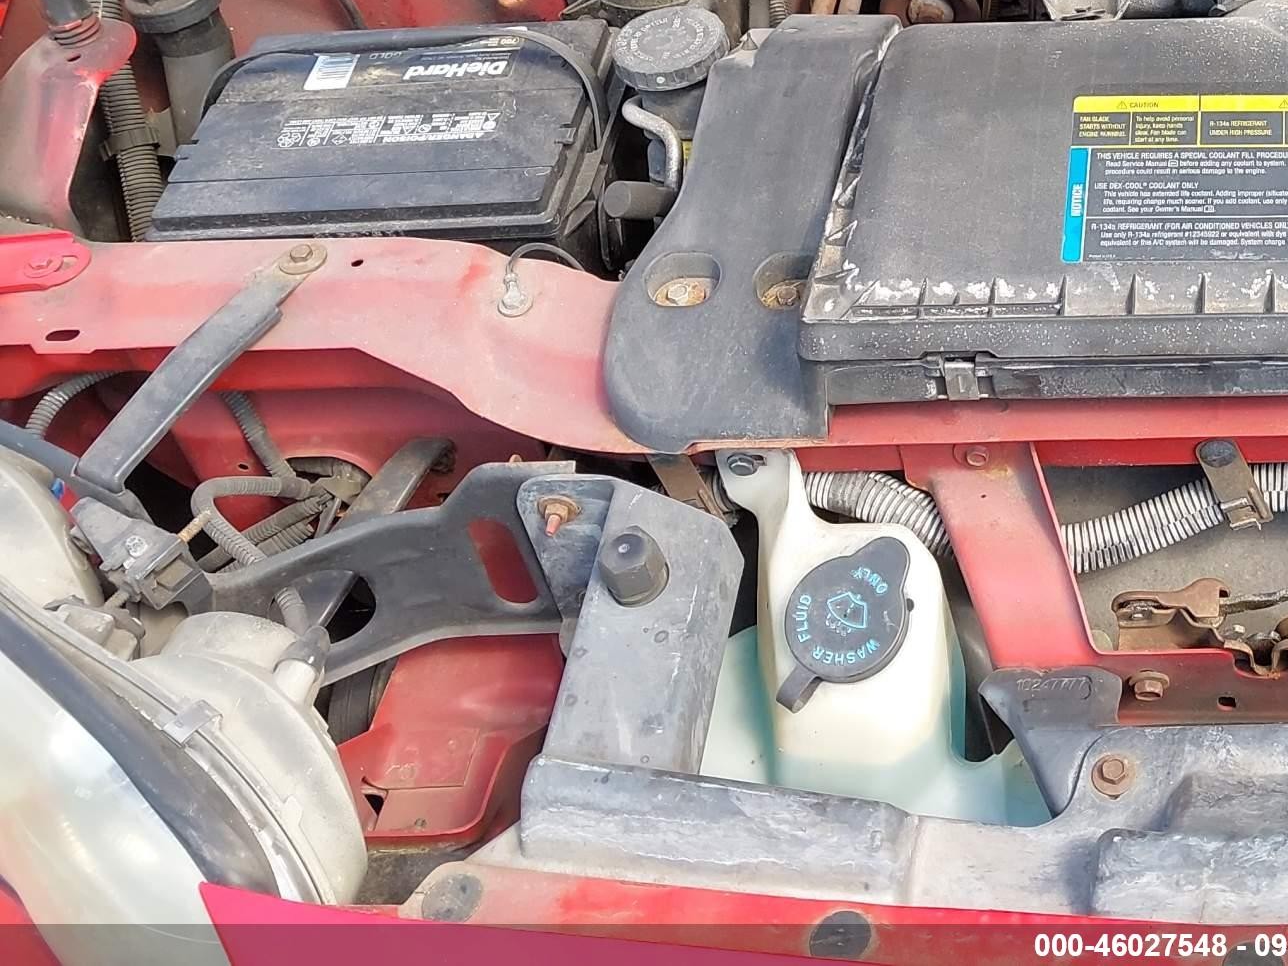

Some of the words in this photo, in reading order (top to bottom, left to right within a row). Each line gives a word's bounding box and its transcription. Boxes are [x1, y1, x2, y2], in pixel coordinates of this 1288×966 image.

[402, 59, 507, 80] DieHard
[1071, 184, 1083, 216] NOTICE
[852, 567, 888, 594] ONLY
[796, 594, 812, 643] FLUID
[812, 638, 880, 665] WASHER
